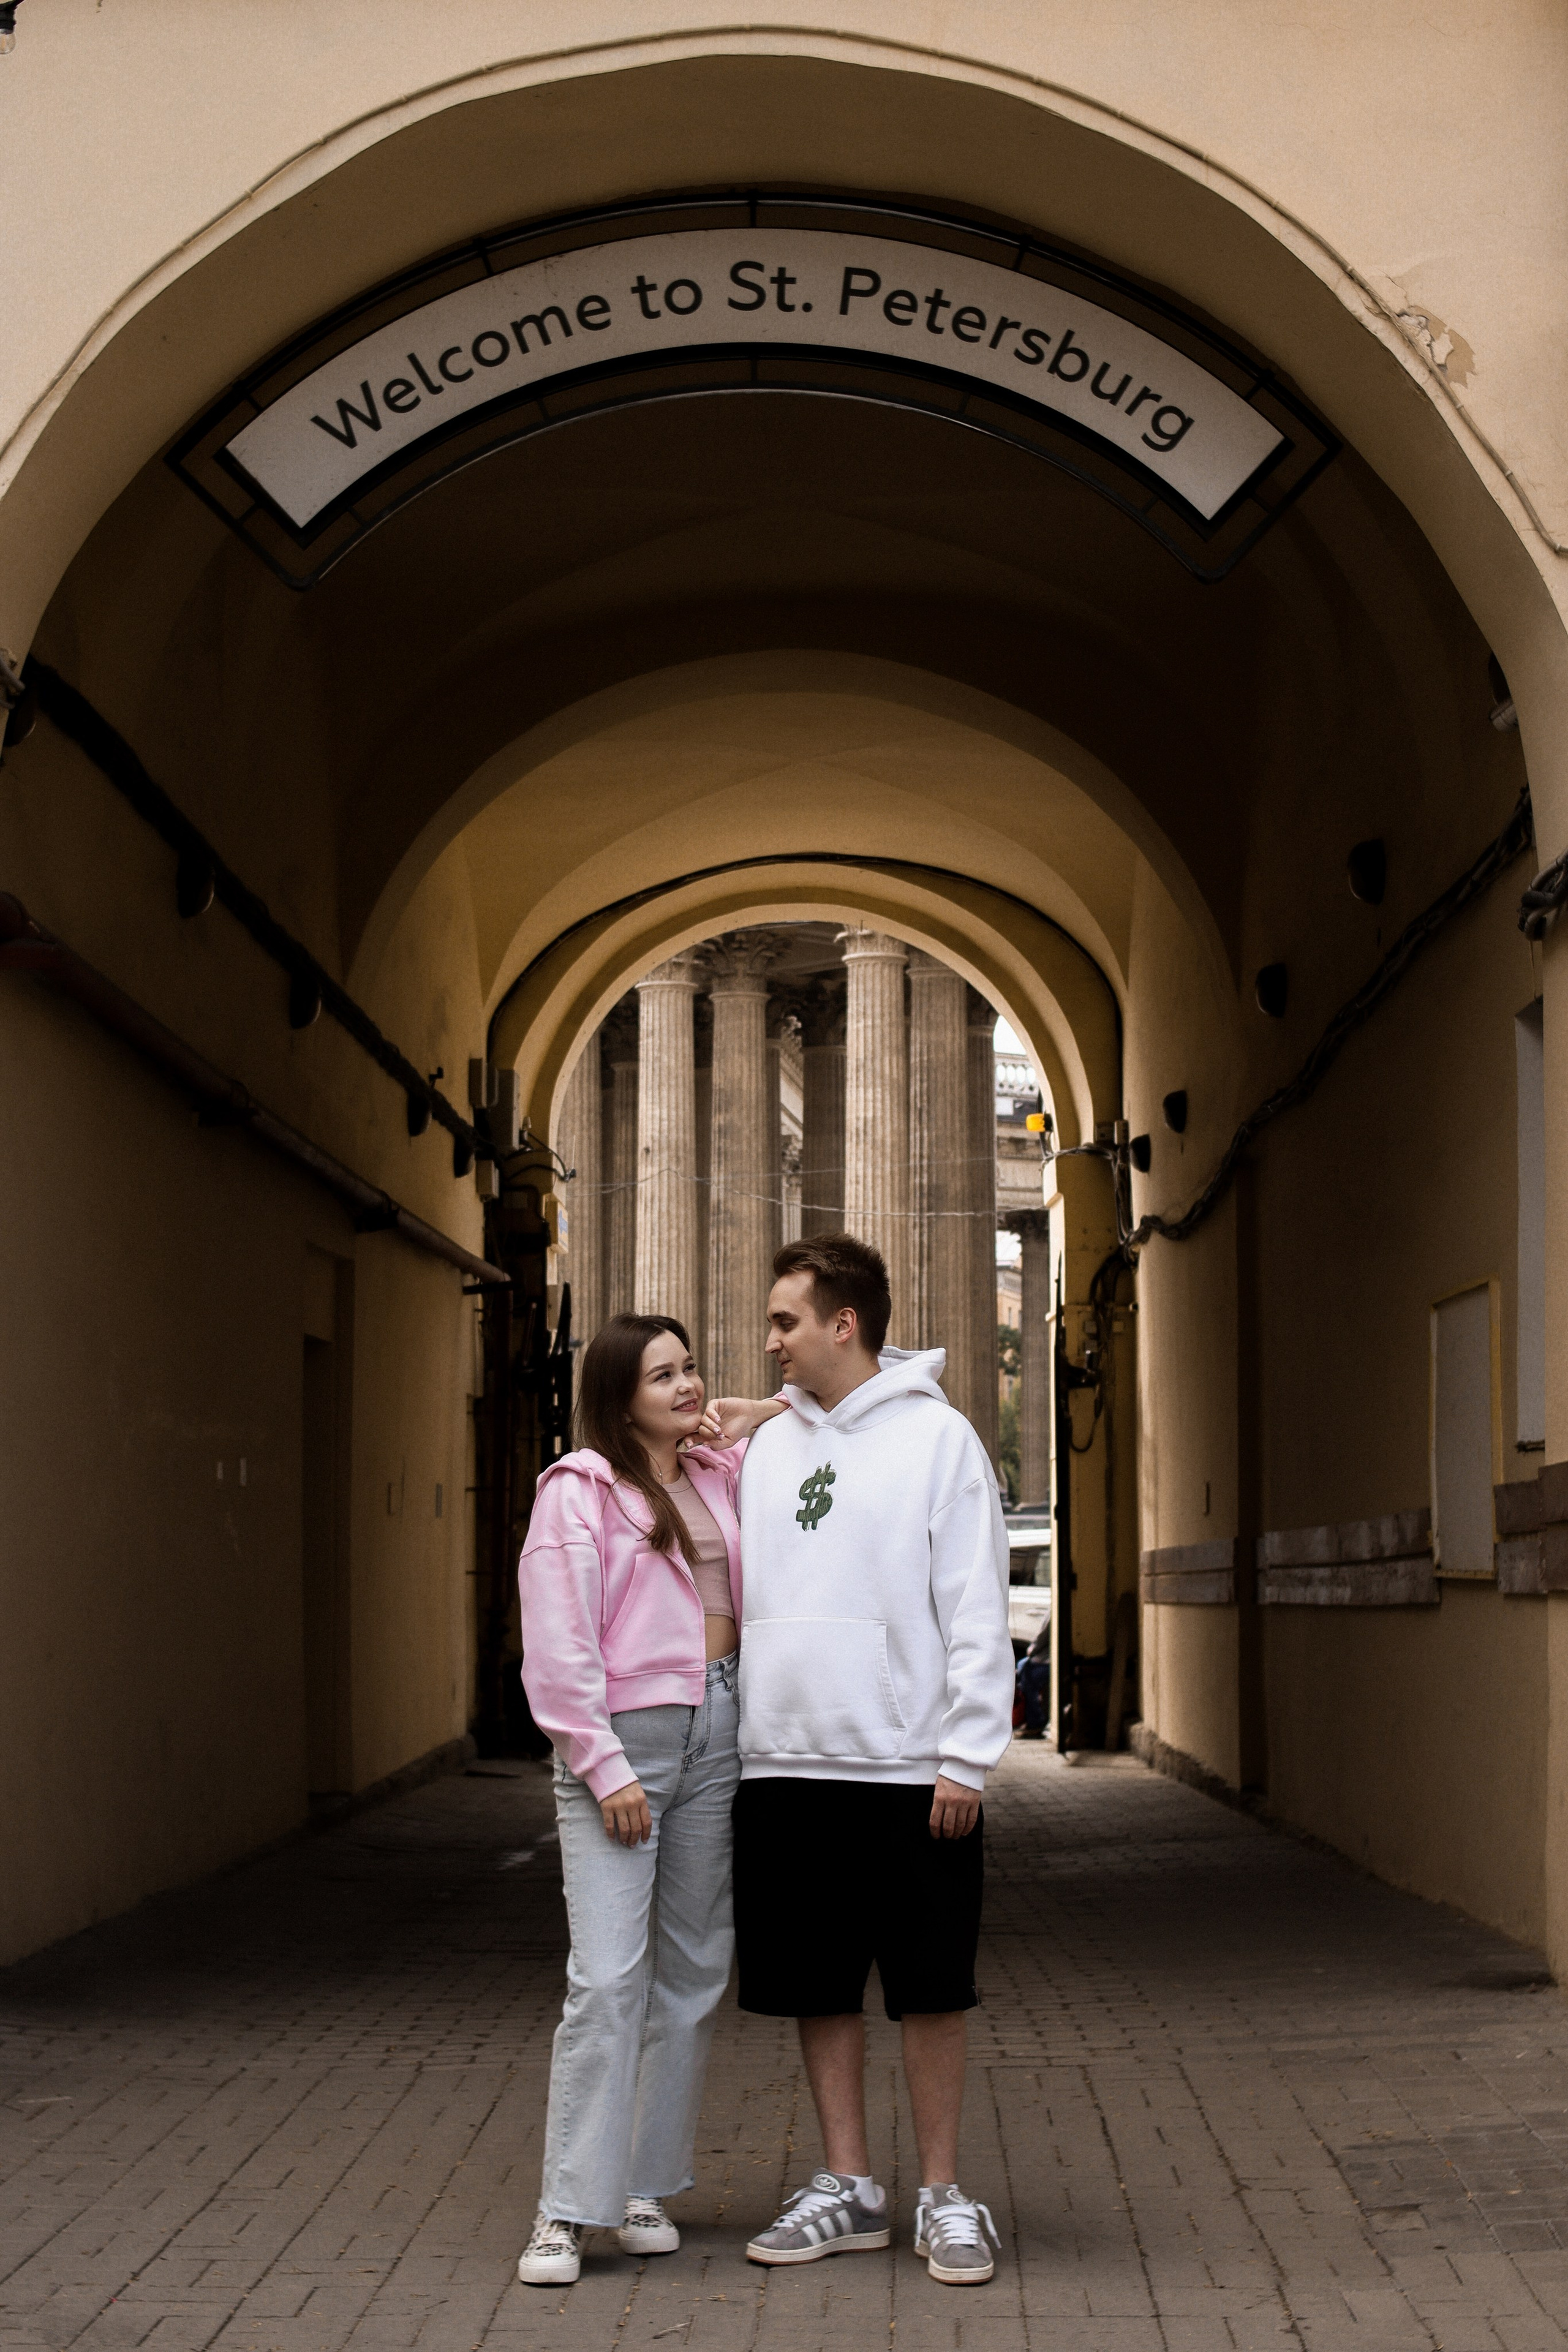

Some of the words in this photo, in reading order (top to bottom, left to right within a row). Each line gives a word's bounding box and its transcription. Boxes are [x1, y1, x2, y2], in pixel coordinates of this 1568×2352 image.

[310, 294, 612, 449] Welcome
[630, 275, 703, 320] to
[727, 260, 814, 314] St.
[839, 266, 1195, 453] Petersburg
